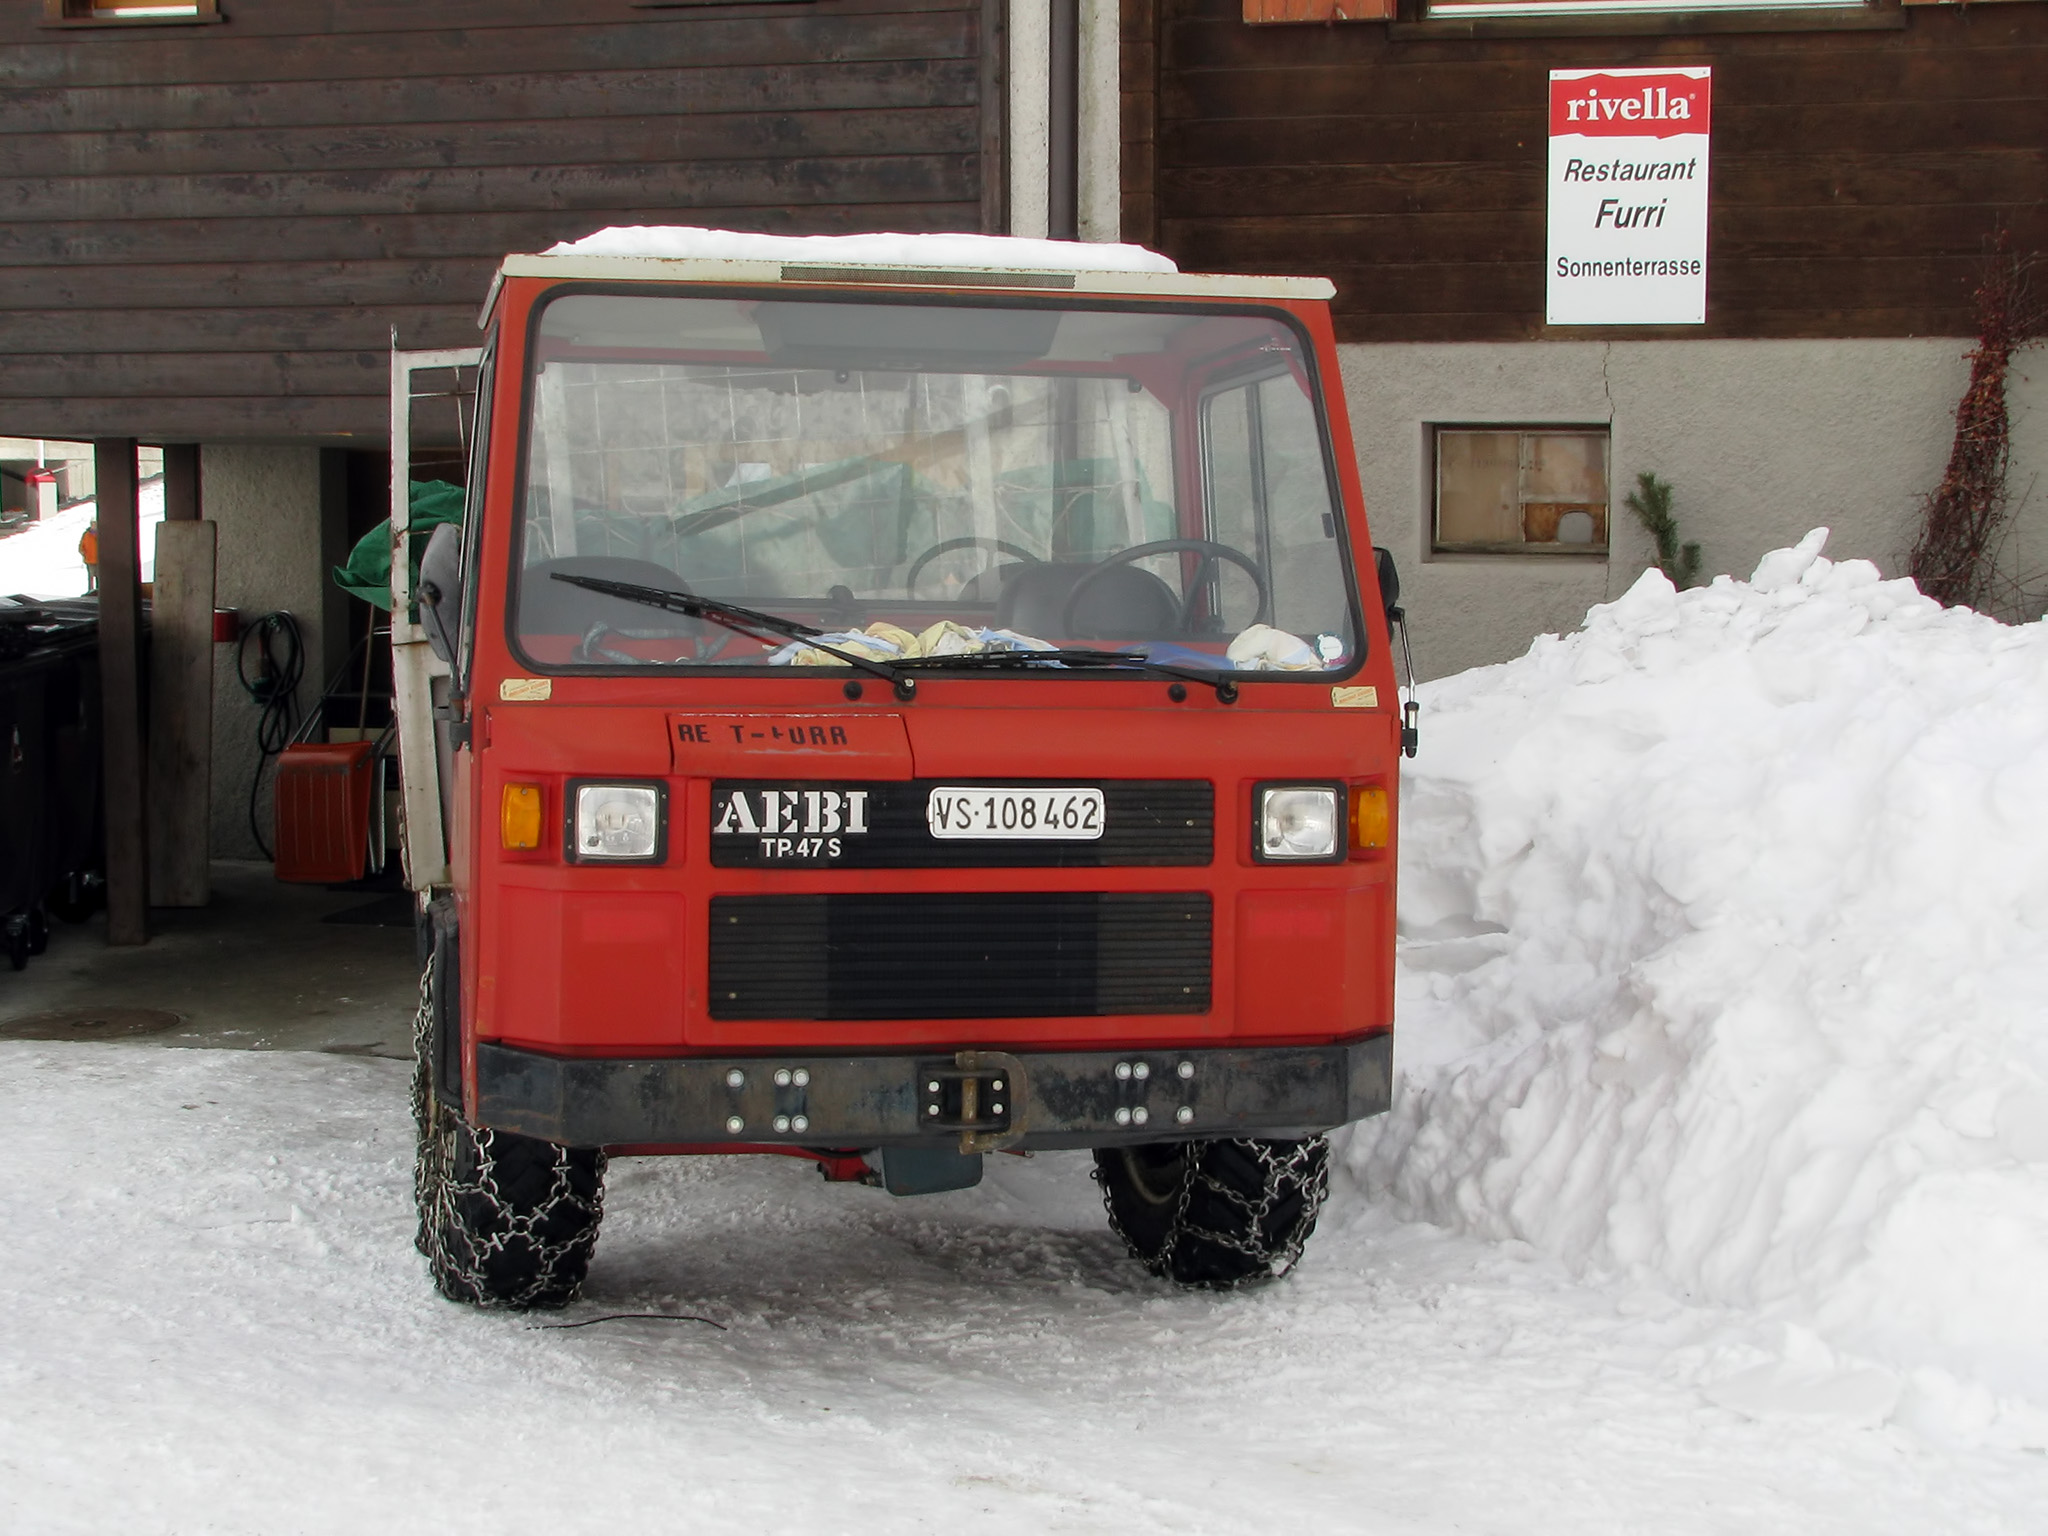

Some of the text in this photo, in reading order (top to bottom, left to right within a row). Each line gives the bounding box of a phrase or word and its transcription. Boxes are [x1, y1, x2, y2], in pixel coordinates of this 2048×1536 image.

[1566, 86, 1692, 121] rivella
[1563, 157, 1697, 183] Restaurant
[1594, 198, 1668, 229] Furri
[1556, 256, 1701, 278] Sonnenterrasse
[712, 790, 869, 834] AEBI
